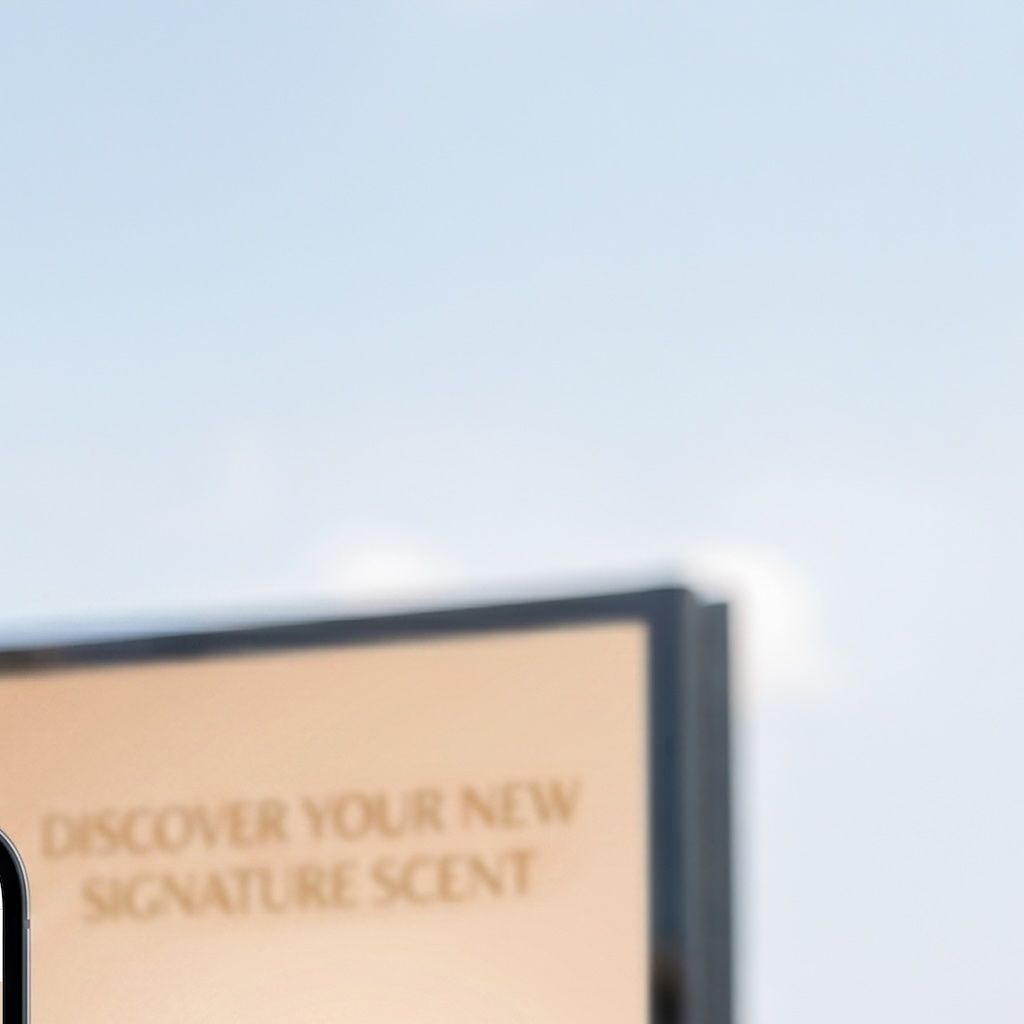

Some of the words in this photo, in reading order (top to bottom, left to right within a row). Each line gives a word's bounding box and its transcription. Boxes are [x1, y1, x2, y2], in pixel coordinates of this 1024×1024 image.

[41, 798, 287, 860] DISCOVER
[302, 787, 447, 843] YOUR
[459, 779, 582, 831] NEW
[82, 863, 357, 923] SIGNATURE
[372, 850, 537, 907] SCENT
